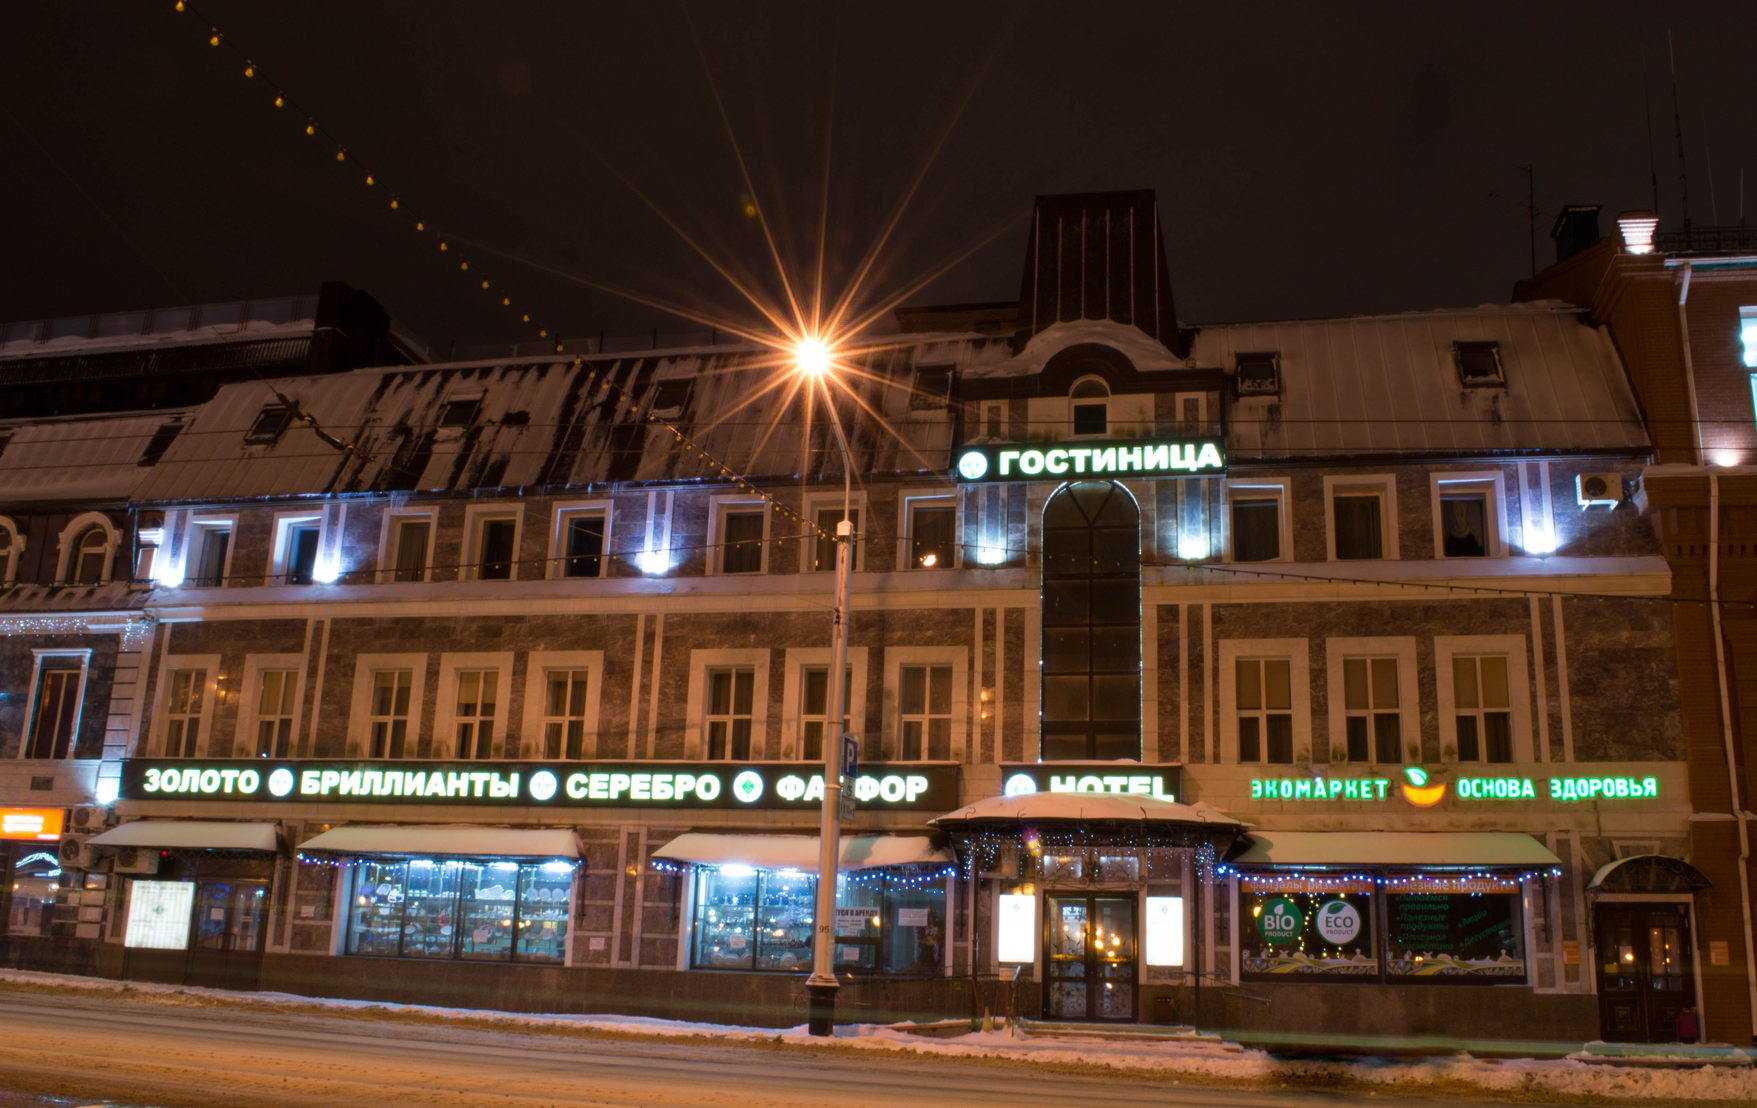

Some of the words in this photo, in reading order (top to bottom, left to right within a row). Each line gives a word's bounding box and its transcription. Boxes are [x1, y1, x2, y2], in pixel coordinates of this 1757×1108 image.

[1000, 443, 1222, 475] ГОСТИНИЦА
[143, 768, 260, 794] ЗОЛОТО
[300, 771, 520, 799] БРИЛЛИАНТЫ
[565, 773, 720, 801] СЕРЕБРО
[776, 775, 928, 802] ФАФОР
[1050, 775, 1174, 803] HOTEL
[1250, 777, 1389, 799] ЭКОМАРКЕТ
[1457, 777, 1535, 798] ОСНОВА
[1550, 777, 1657, 800] ЗДОРОВЬЯ
[1264, 914, 1295, 930] BIO
[1325, 916, 1354, 928] ECO
